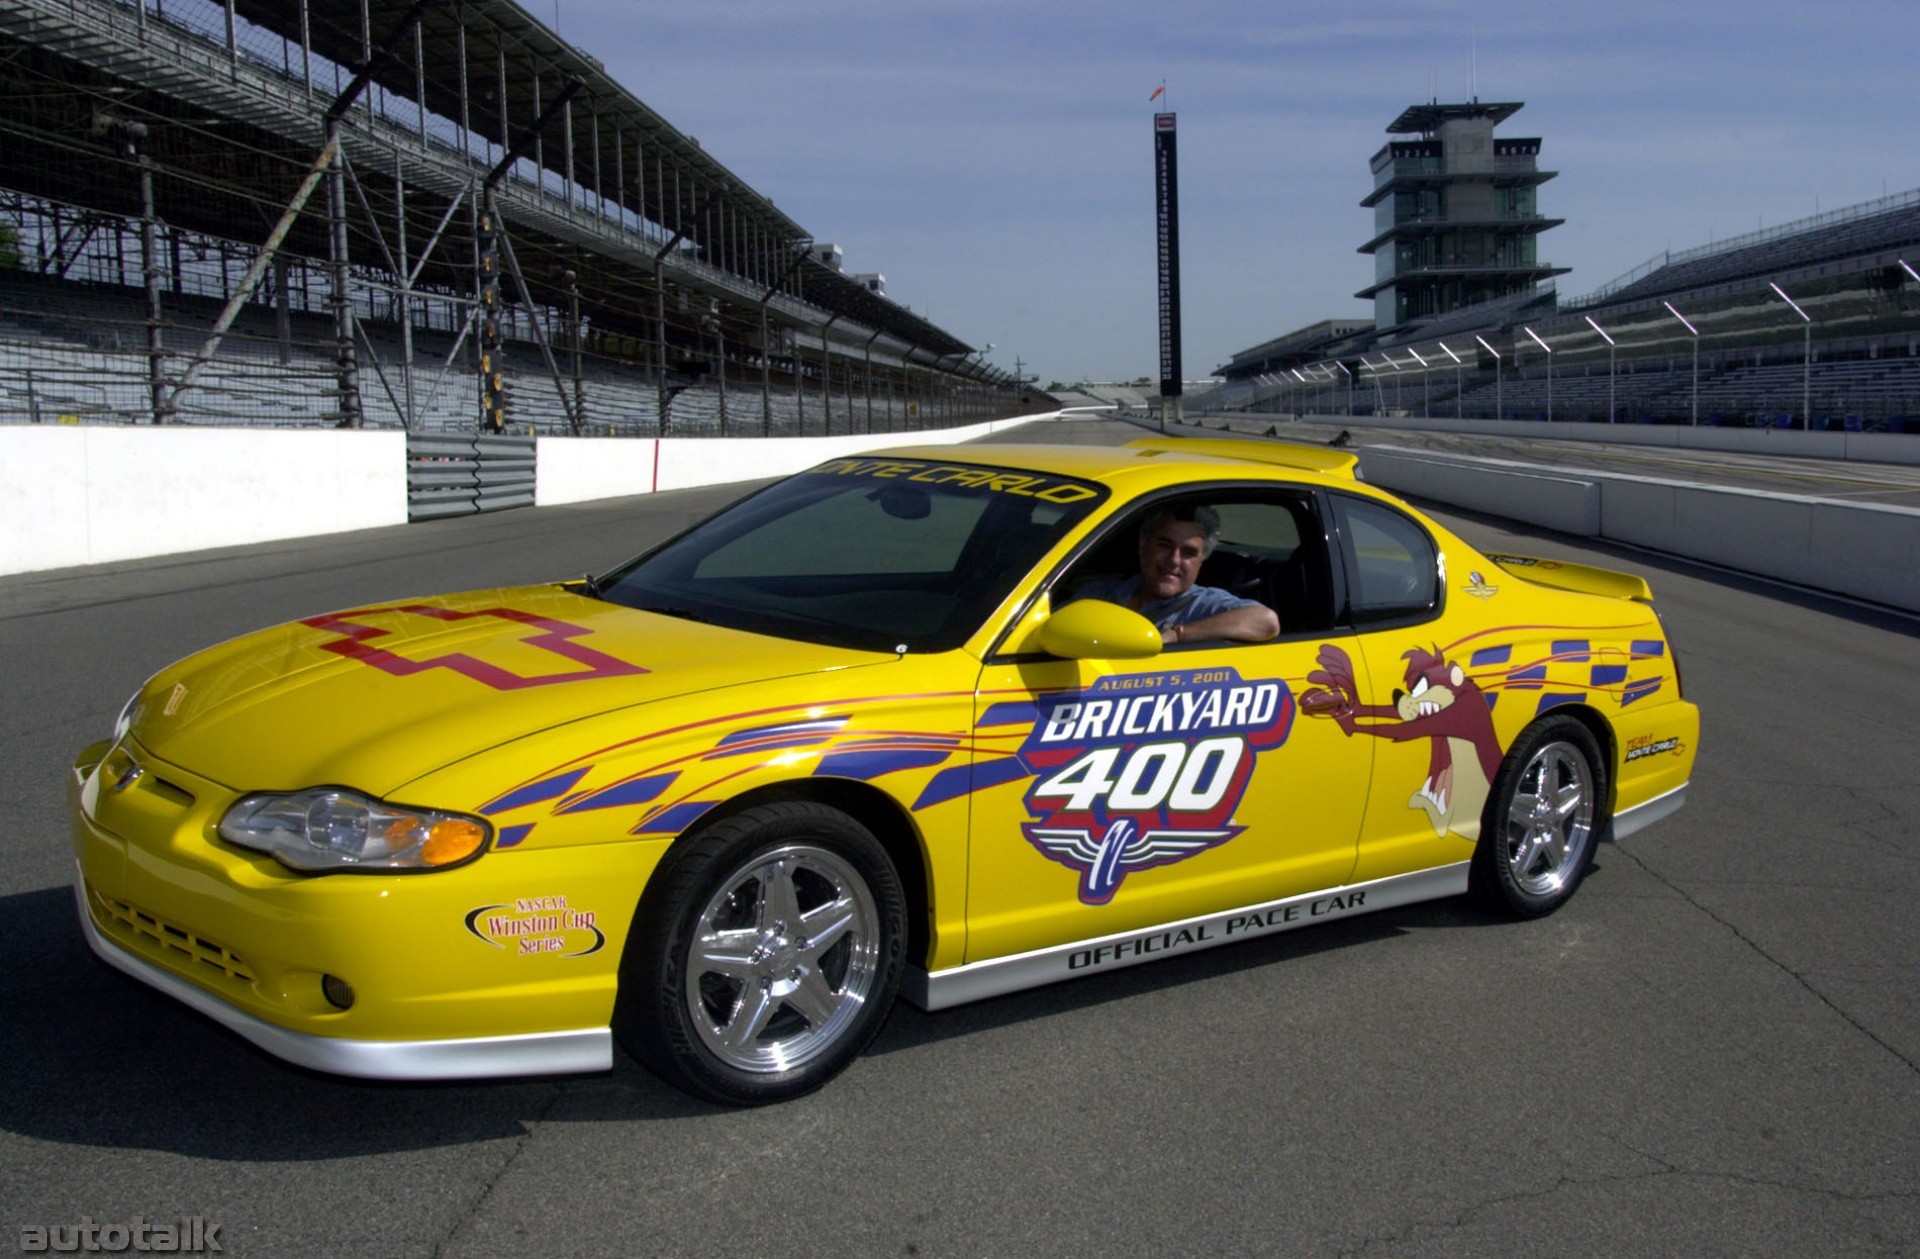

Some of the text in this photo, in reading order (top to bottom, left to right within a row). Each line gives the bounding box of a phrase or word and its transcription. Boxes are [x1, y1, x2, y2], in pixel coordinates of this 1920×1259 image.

[804, 460, 1098, 504] ONTE CARLO
[1099, 671, 1230, 691] AUGUST 5, 2001
[1040, 683, 1279, 743] BRICKYARD
[1034, 735, 1246, 811] 400
[516, 895, 567, 912] NASCAR
[488, 909, 596, 937] Winston Cup
[1068, 891, 1366, 970] OFFICIAL PACE CAR
[519, 936, 565, 955] Series
